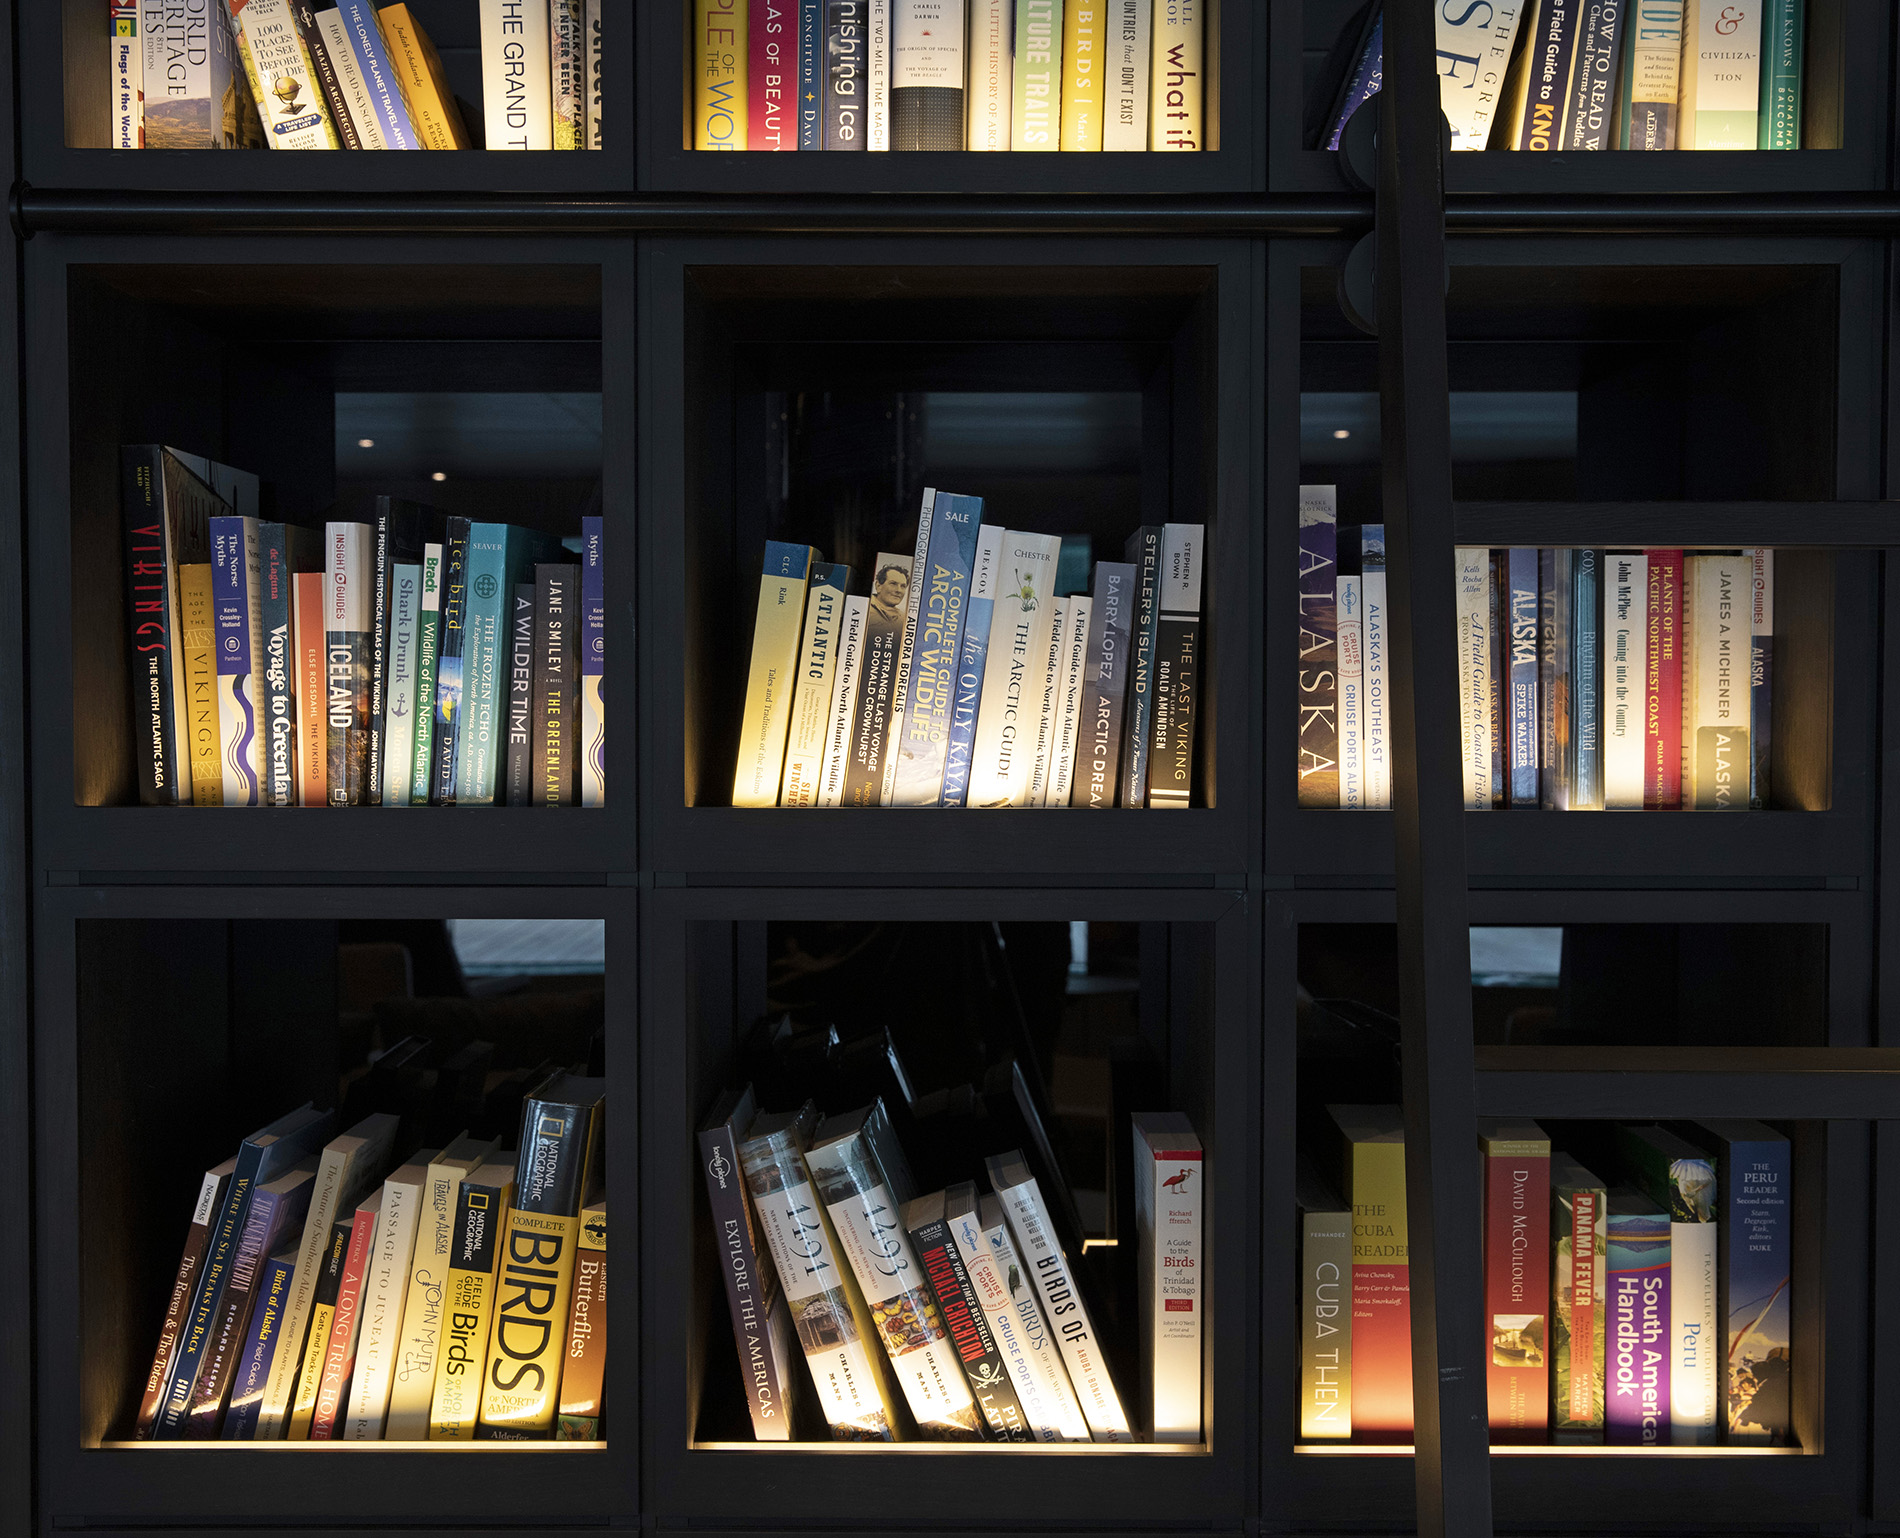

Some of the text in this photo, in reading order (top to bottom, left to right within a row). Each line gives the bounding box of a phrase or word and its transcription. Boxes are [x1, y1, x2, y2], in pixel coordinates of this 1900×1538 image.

[253, 34, 293, 49] PLACES
[257, 24, 283, 37] 1,000
[260, 55, 300, 72] BEFORE
[286, 65, 305, 76] DIE
[874, 19, 883, 107] TWO-MILE TIME
[1076, 11, 1093, 88] BIRDS
[1784, 19, 1794, 66] KNOWS
[119, 45, 131, 148] Flags of the World
[504, 43, 527, 128] GRAND
[839, 104, 859, 140] Ice
[1024, 72, 1050, 143] TRAILS
[1166, 43, 1196, 149] what if
[215, 535, 227, 567] Myths
[376, 534, 385, 572] PENGUIN
[945, 512, 970, 523] SALE
[229, 534, 240, 587] The Norse
[335, 534, 347, 620] INSIGHT GUIDES
[375, 574, 384, 620] HISTORICAL
[425, 557, 438, 592] Bradt
[449, 539, 466, 629] ice bird
[978, 549, 991, 595] HEACOX
[1617, 561, 1632, 620] John McPhee
[374, 623, 383, 647] ATLAS
[396, 578, 413, 683] Shark Drunk
[809, 593, 834, 679] ATLANTIC
[909, 564, 949, 742] ARCTIC WILDLIFE
[1649, 566, 1659, 736] PACIFIC NORTHWEST COAST
[1663, 566, 1673, 660] PLANTS OF THE
[1719, 570, 1731, 718] JAMES A. MICHENER
[130, 525, 166, 789] VIKINGS THE NORTH ATLANTIC SAGA
[267, 624, 290, 715] Voyage to
[329, 644, 353, 728] ICELAND
[373, 664, 381, 678] THE
[374, 650, 381, 661] OF
[479, 615, 494, 742] THE FROZEN ECHO
[511, 597, 531, 744] A WILDER TIME
[894, 616, 915, 713] AURORA BOREALIS
[1094, 575, 1121, 755] BARRY LOPEZ ARCTIC
[1299, 546, 1335, 780] ALASKA
[1613, 629, 1630, 737] Coming into the Country
[193, 653, 212, 757] VIKINGS
[308, 649, 320, 780] ELSE ROESDAHL THE VIKINGS
[372, 680, 381, 715] VIKINGS
[415, 622, 434, 788] Wildlife of the North Atlantic
[858, 636, 881, 764] OF DONALD CROWHURST
[867, 631, 893, 772] THE STRANGE LAST VOYAGE
[1156, 661, 1170, 749] ROALD AMUNDSEN
[1174, 632, 1194, 780] THE LAST VIKING
[1346, 685, 1356, 769] CRUISE PORTS
[1516, 684, 1527, 768] SPIKE WALKER
[370, 752, 379, 791] HAYWOOD
[371, 730, 380, 750] JOHN
[531, 1138, 549, 1201] GEOGRAPHIC
[544, 1140, 559, 1189] NATIONAL
[1743, 1186, 1778, 1194] READER
[1744, 1172, 1777, 1183] PERU
[1753, 1163, 1769, 1171] THE
[383, 1191, 402, 1261] PASSAGE
[512, 1216, 565, 1231] COMPLETE
[786, 1204, 829, 1277] 1491
[863, 1204, 909, 1277] 1493
[1353, 1225, 1394, 1236] CUBA
[1355, 1204, 1385, 1216] THE
[1576, 1197, 1593, 1258] PANAMA
[945, 1243, 993, 1353] NEW YORK TIMES BESTSELLER
[1164, 1257, 1194, 1267] Birds
[1575, 1262, 1591, 1306] FEVER
[148, 1256, 195, 1393] The Raven & The Totem
[369, 1268, 391, 1359] TO JUNEAU
[447, 1312, 478, 1376] Birds
[491, 1228, 564, 1392] BIRDS
[571, 1259, 598, 1358] Butterflies
[725, 1219, 774, 1418] EXPLORE THE AMERICAS
[922, 1246, 985, 1363] MICHAEL CRICHTON
[1016, 1299, 1048, 1351] BIRDS
[1314, 1262, 1340, 1421] CUBA THEN
[1616, 1277, 1639, 1396] Handbook
[1642, 1277, 1663, 1343] South
[315, 1272, 359, 1440] A LONG TREK HOME
[1683, 1323, 1701, 1368] Peru
